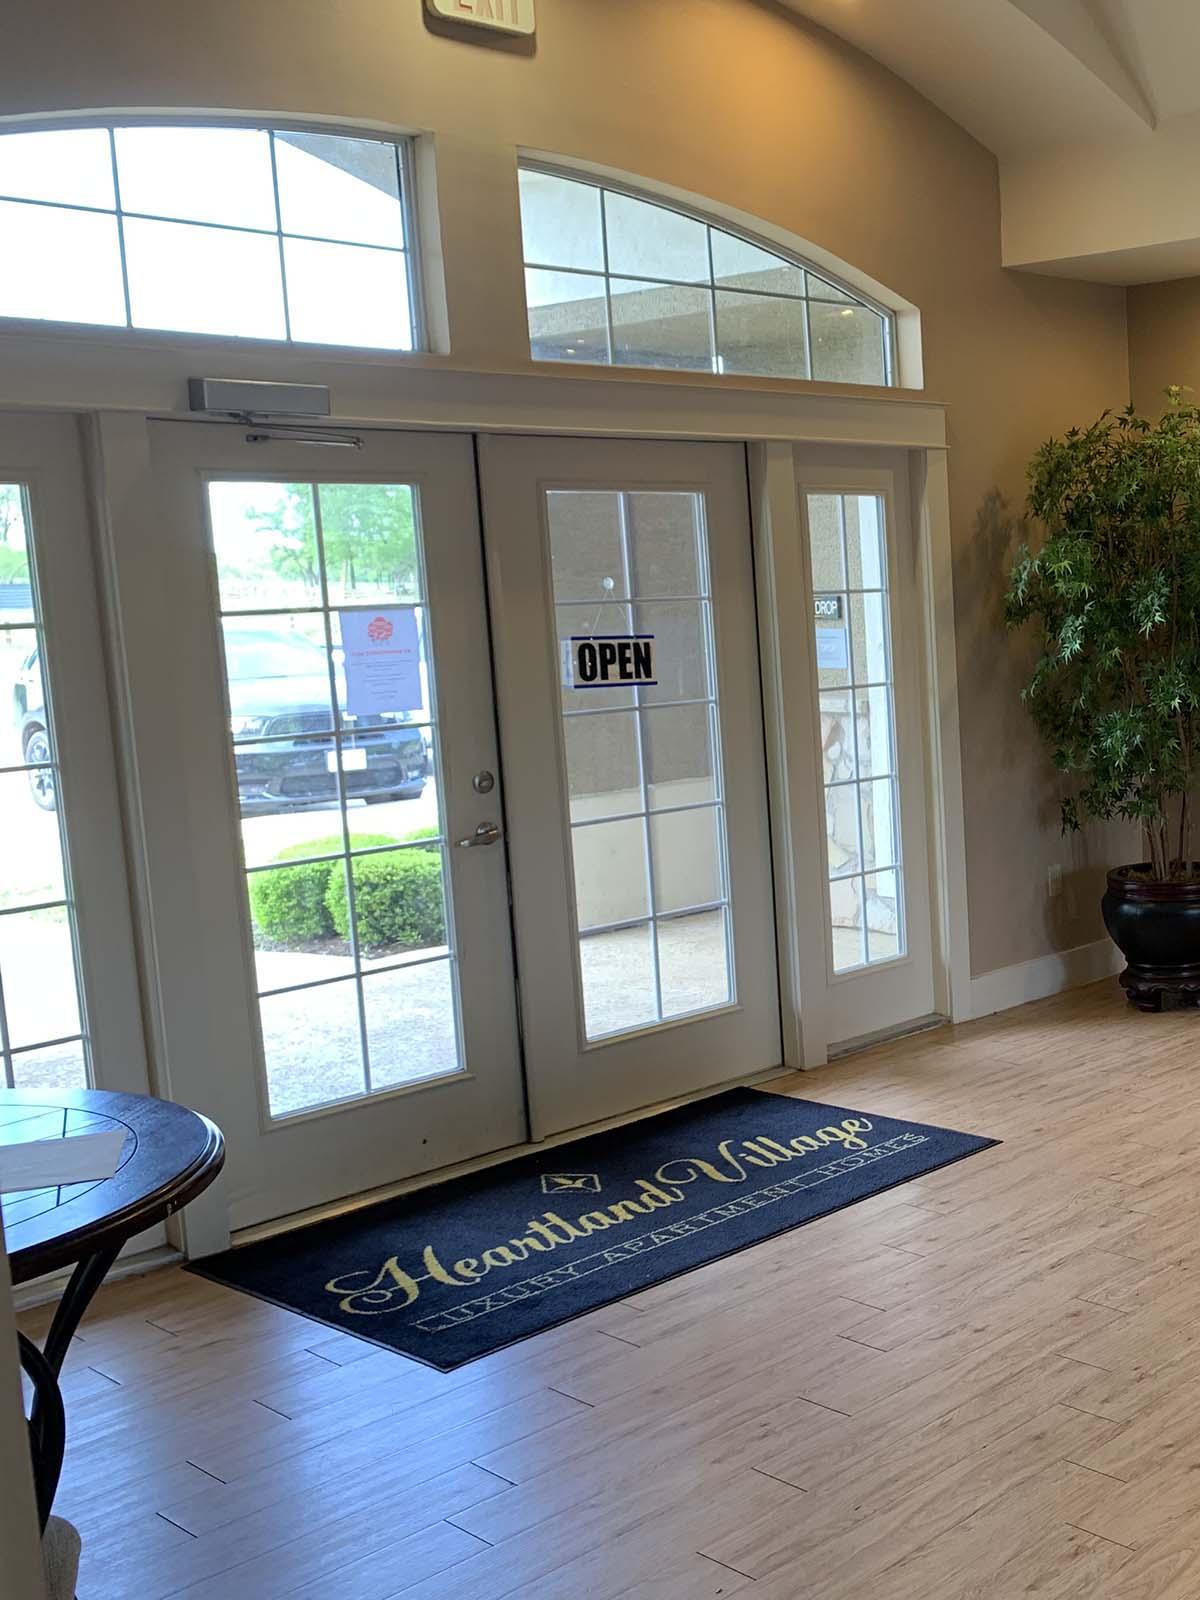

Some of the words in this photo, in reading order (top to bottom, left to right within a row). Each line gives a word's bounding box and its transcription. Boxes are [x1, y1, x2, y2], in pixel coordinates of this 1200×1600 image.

[577, 642, 653, 682] OPEN
[815, 600, 837, 615] DROP
[324, 1179, 686, 1315] Heartland
[655, 1117, 874, 1183] Village
[412, 1264, 580, 1335] LUXURY
[603, 1176, 809, 1264] APARTMENT
[816, 1132, 931, 1178] HOMES
